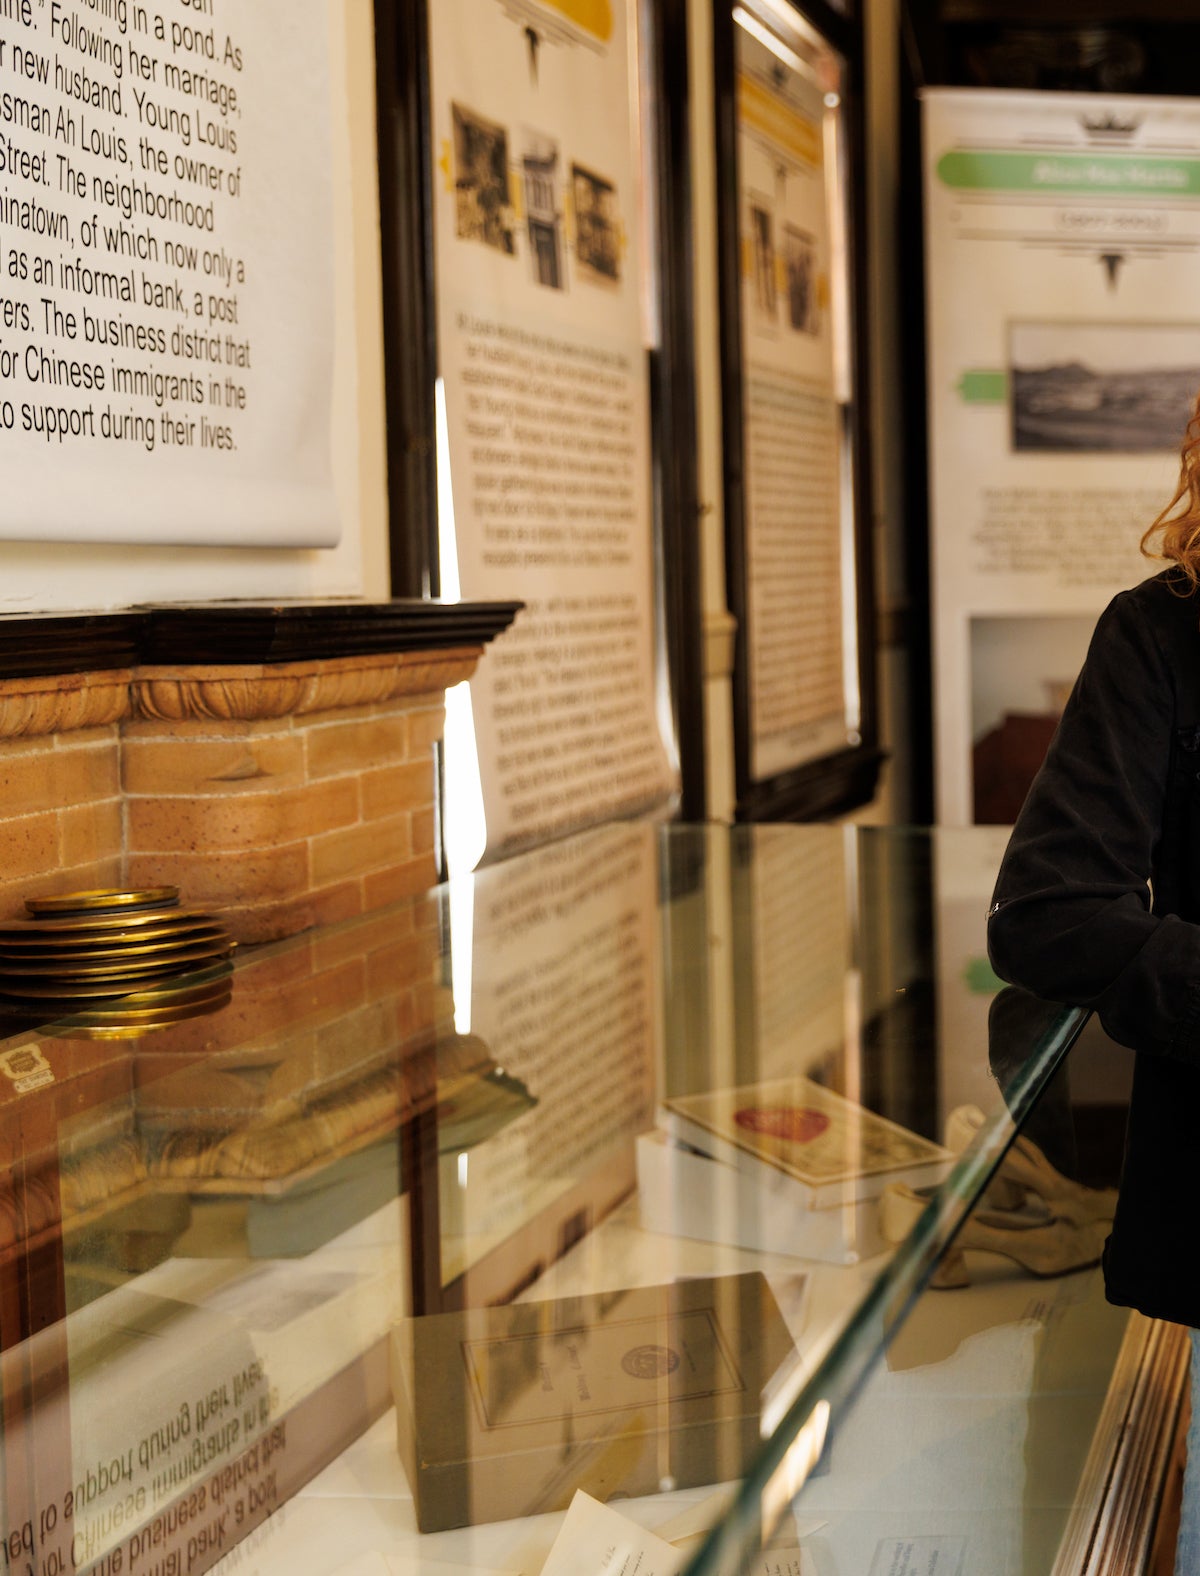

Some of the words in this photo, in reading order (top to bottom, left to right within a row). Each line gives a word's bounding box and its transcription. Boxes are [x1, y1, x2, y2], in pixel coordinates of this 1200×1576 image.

[50, 2, 123, 79] Following
[129, 40, 158, 82] her
[164, 62, 242, 120] marriage,
[133, 0, 147, 34] in
[154, 15, 165, 40] a
[172, 21, 220, 62] pond.
[224, 36, 243, 72] As
[13, 45, 50, 85] new
[55, 53, 128, 118] husband.
[133, 87, 191, 146] Young
[197, 109, 238, 154] Louis
[0, 92, 51, 137] sman
[55, 105, 76, 147] Ah
[81, 115, 133, 171] Louis,
[139, 136, 169, 175] the
[174, 154, 224, 191] owner
[227, 167, 242, 198] of
[56, 153, 87, 199] The
[93, 174, 214, 232] neighborhood
[8, 249, 27, 280] as
[33, 255, 53, 286] an
[60, 254, 136, 303] informal
[142, 272, 189, 319] bank,
[194, 292, 203, 317] a
[209, 294, 238, 325] post
[81, 214, 98, 248] of
[103, 221, 158, 262] which
[165, 241, 198, 271] now
[203, 247, 232, 287] only
[237, 258, 245, 284] a
[0, 298, 34, 332] ers.
[41, 298, 77, 339] The
[83, 307, 166, 353] business
[171, 323, 222, 364] district
[226, 332, 251, 368] that
[0, 339, 19, 379] or
[25, 345, 105, 390] Chinese
[111, 358, 204, 407] immigrants
[209, 374, 221, 406] in
[225, 377, 246, 410] the
[0, 400, 14, 429] o
[21, 403, 96, 443] support
[101, 404, 155, 451] during
[161, 411, 196, 446] their
[200, 415, 238, 450] lives.
